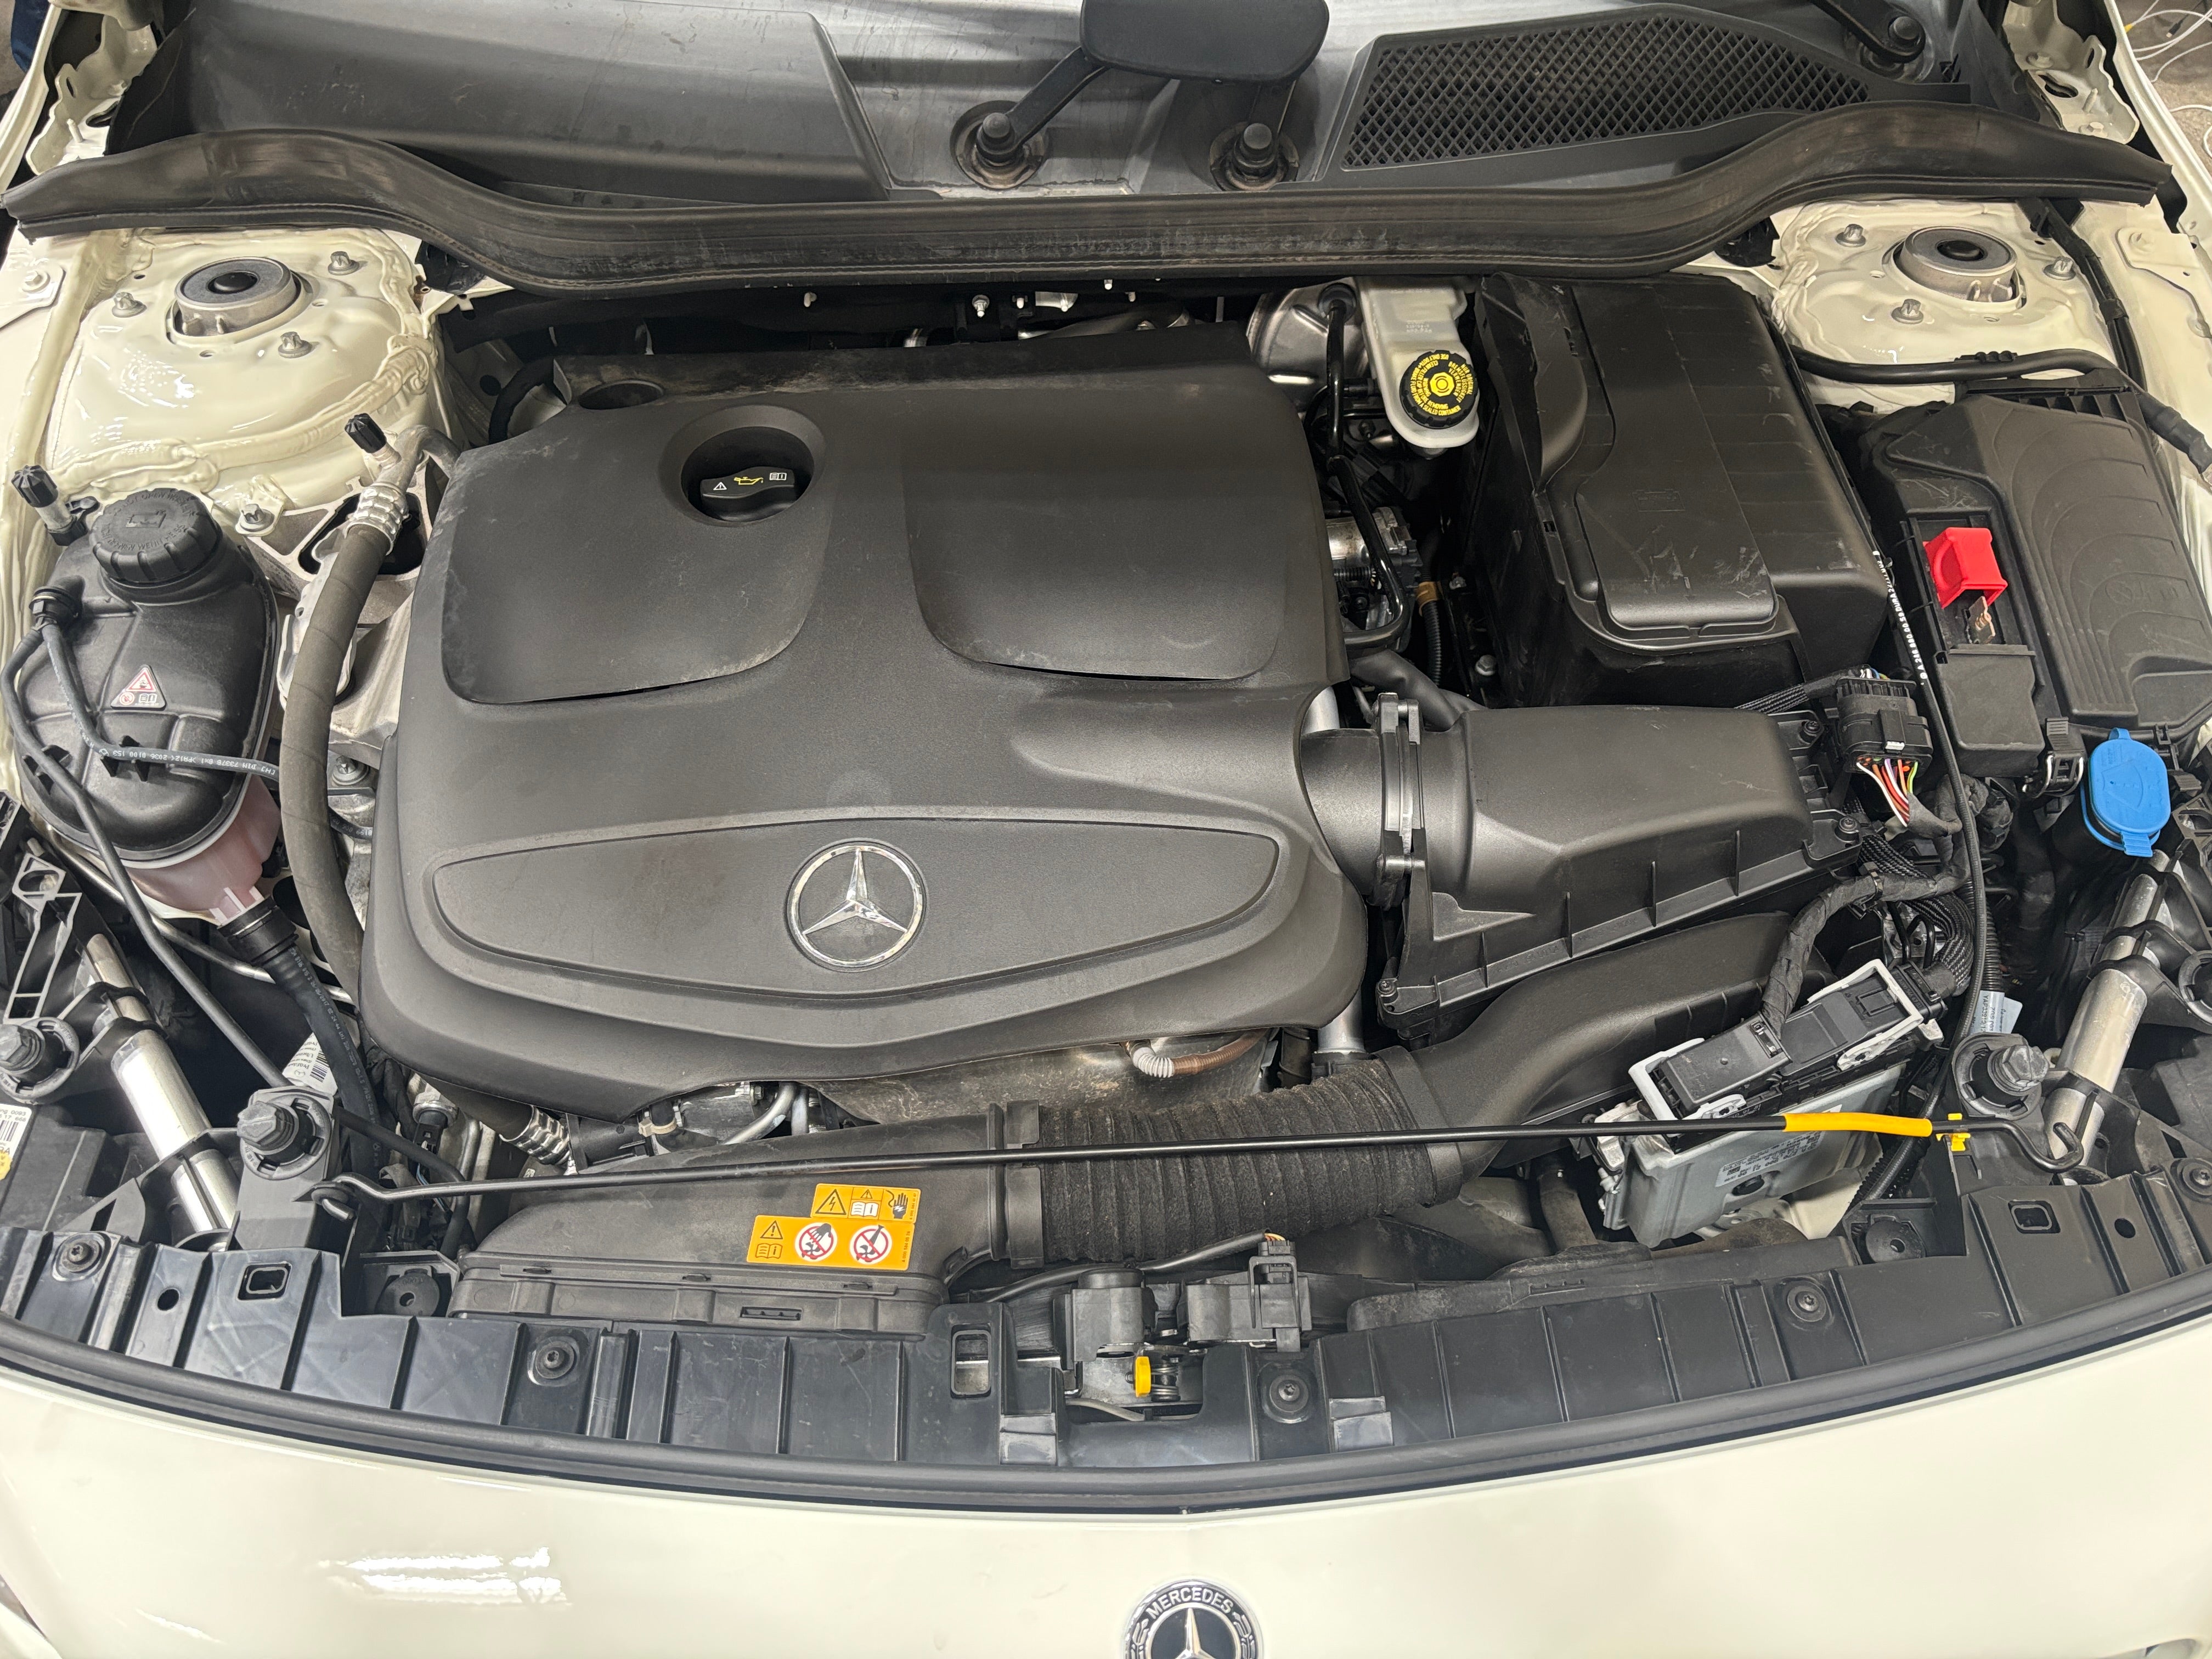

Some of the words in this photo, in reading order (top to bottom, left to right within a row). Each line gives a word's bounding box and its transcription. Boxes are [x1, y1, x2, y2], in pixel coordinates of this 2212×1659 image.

[1460, 363, 1470, 374] NUR
[1448, 361, 1468, 403] BREMSFLÜSSIGKEIT
[1448, 368, 1462, 397] VERWENDEN
[1427, 400, 1448, 409] REMOVING
[1423, 405, 1438, 415] SEALED
[1438, 405, 1462, 416] CONTAINER
[1902, 623, 1911, 633] 00
[1146, 1587, 1234, 1620] MERCEDES
